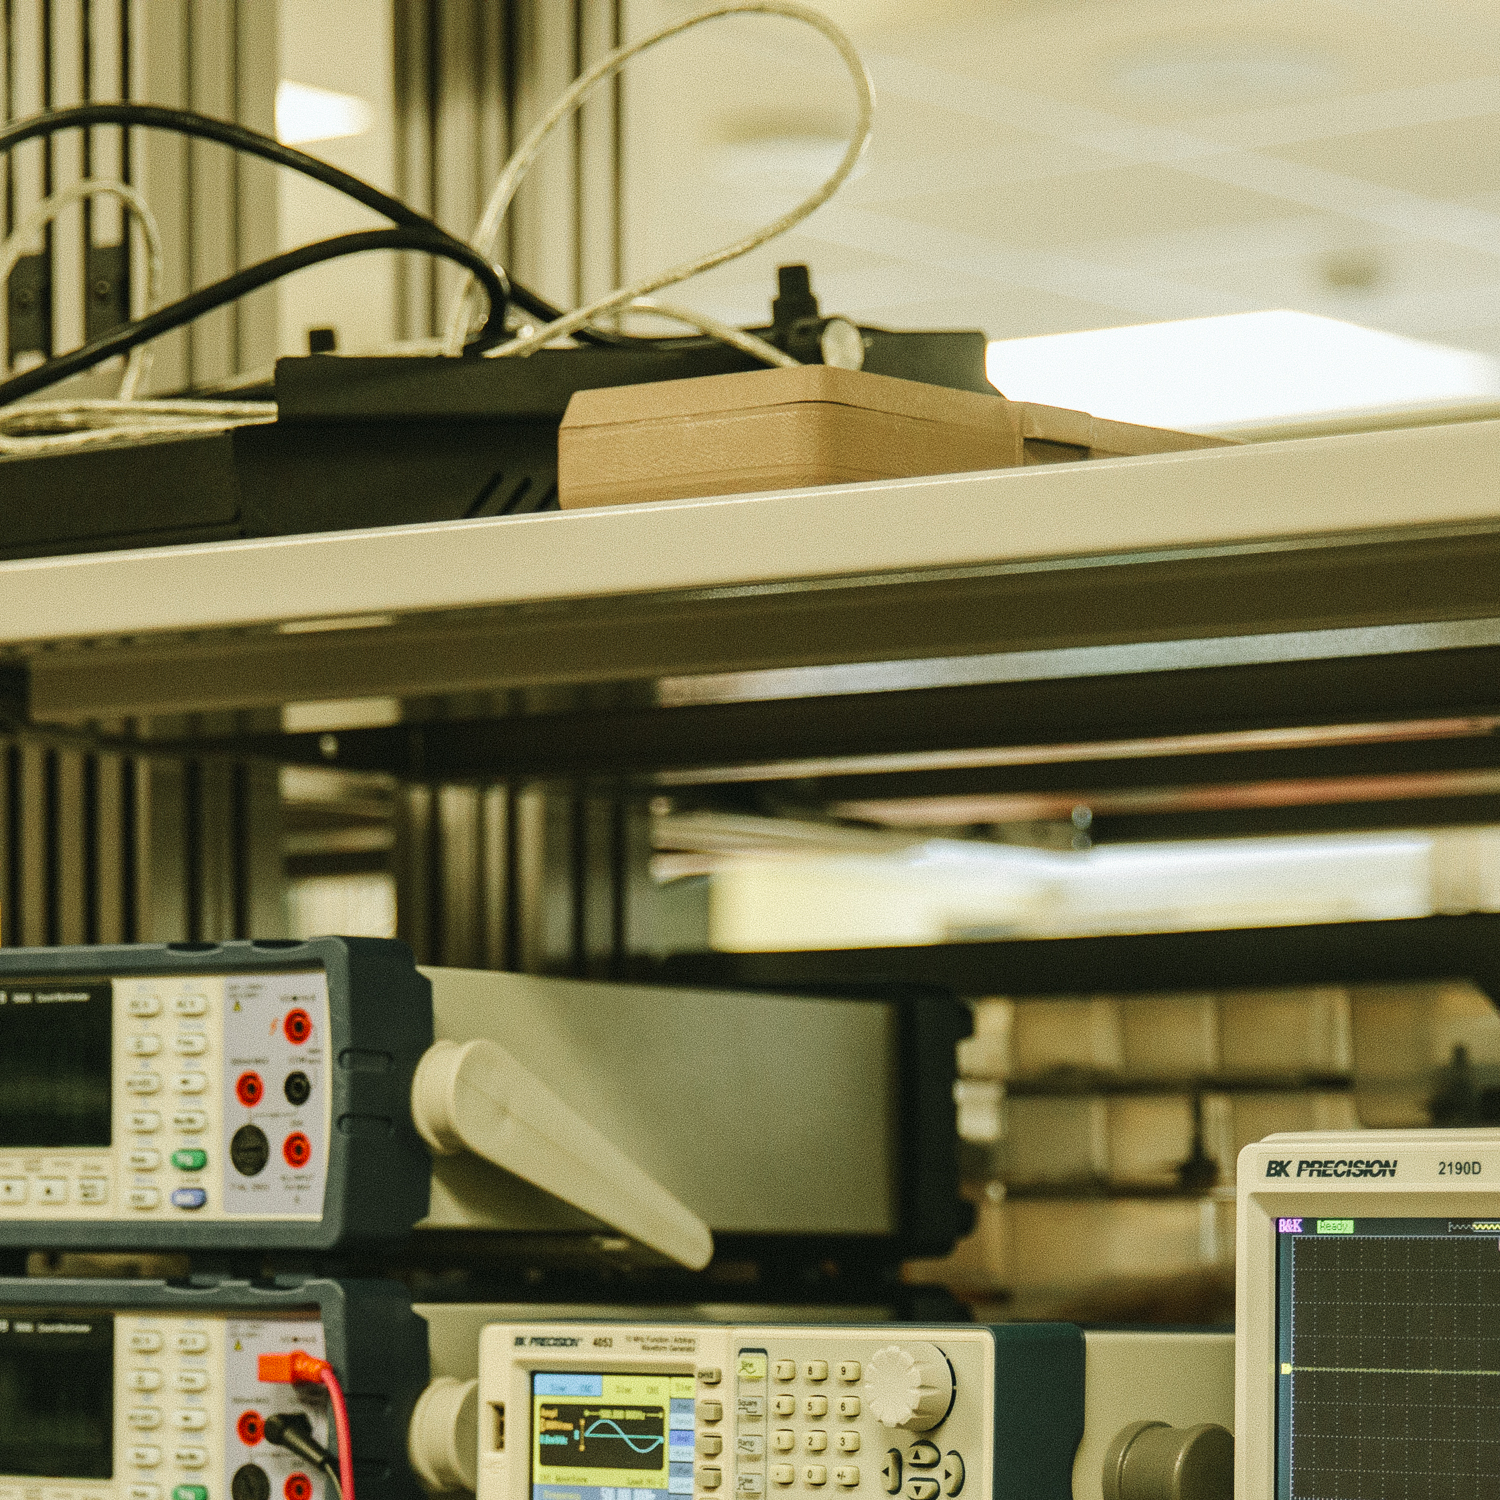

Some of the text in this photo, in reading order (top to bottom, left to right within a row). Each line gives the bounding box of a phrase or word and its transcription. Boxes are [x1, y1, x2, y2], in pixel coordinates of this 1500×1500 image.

[1265, 1159, 1398, 1178] BK PRECISION
[1437, 1161, 1483, 1176] 2190D
[1319, 1220, 1349, 1234] Ready
[529, 1336, 580, 1348] PRECISION
[776, 1365, 782, 1375] 7
[807, 1366, 813, 1376] 8
[841, 1366, 847, 1376] 9
[775, 1401, 781, 1411] 4
[807, 1402, 813, 1412] 5
[840, 1402, 846, 1412] 6
[776, 1436, 781, 1446] 1
[808, 1436, 813, 1446] 2
[840, 1436, 846, 1447] 3
[807, 1469, 813, 1479] 0
